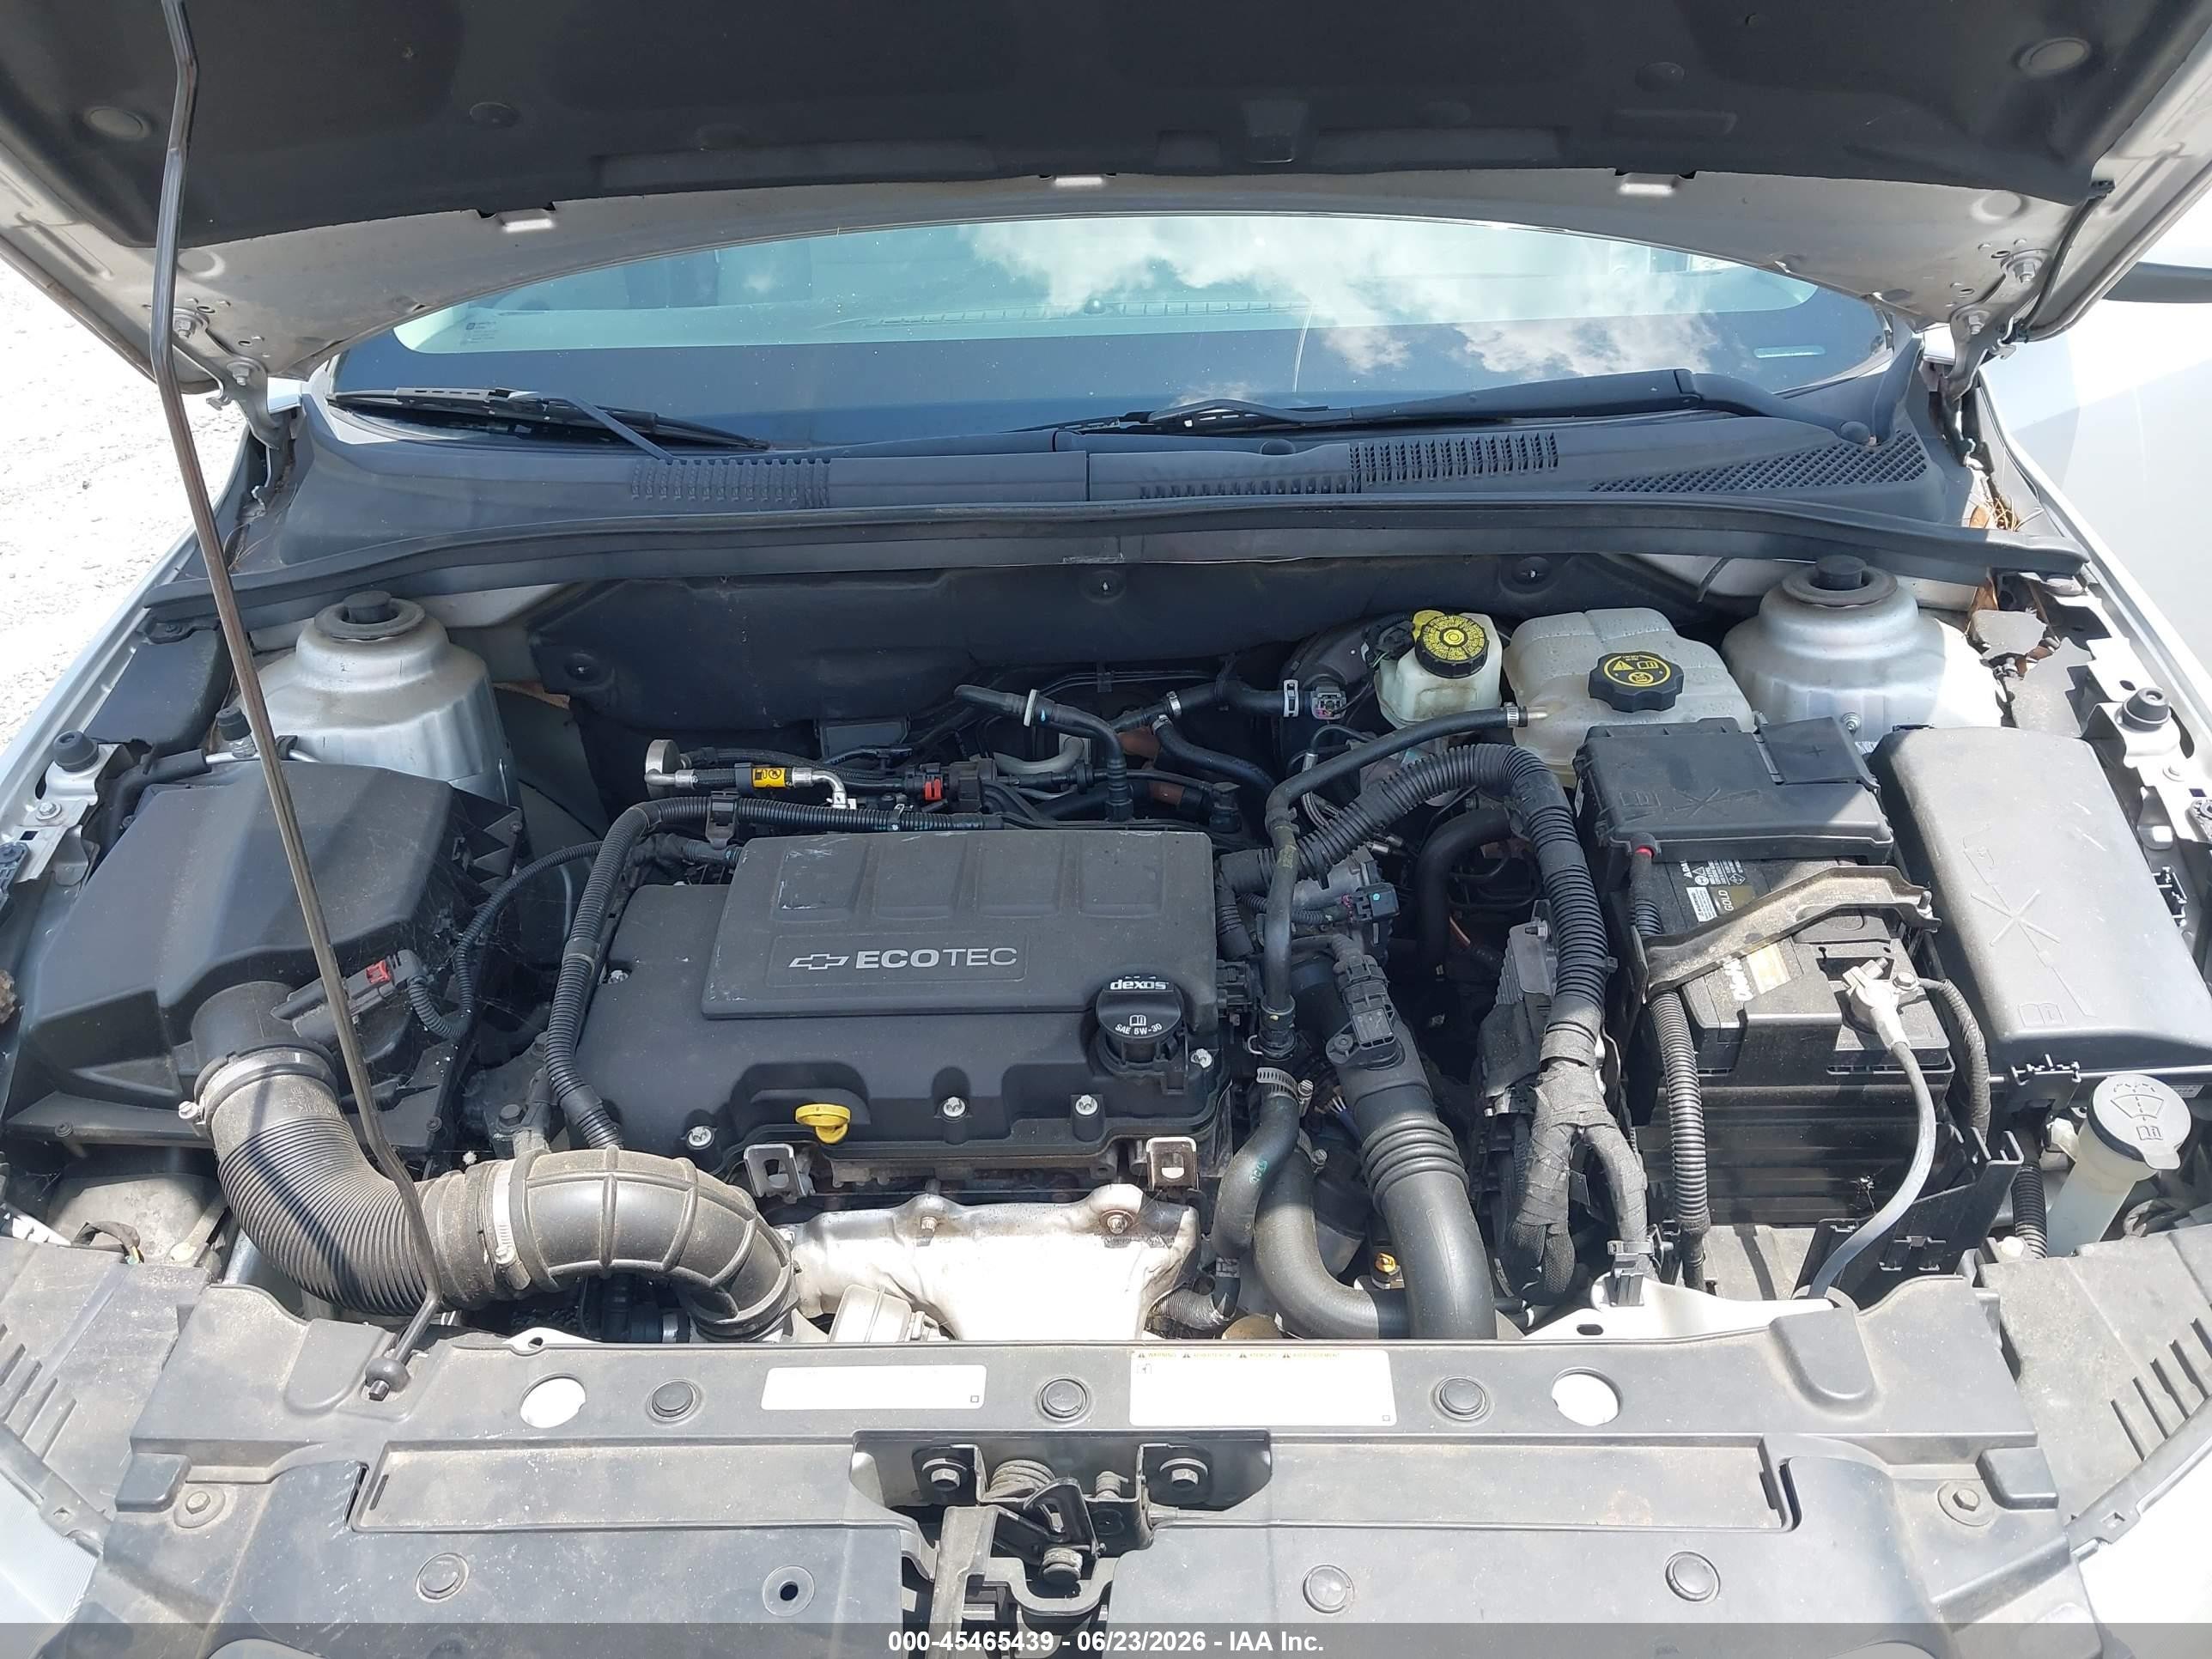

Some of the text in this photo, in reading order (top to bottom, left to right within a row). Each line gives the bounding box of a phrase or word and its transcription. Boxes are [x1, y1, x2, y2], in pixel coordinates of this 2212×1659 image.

[1718, 890, 1734, 911] GOLD
[856, 947, 1018, 969] ECOTEC
[1110, 979, 1168, 990] dexos
[1115, 1023, 1163, 1036] SAE 5W-30
